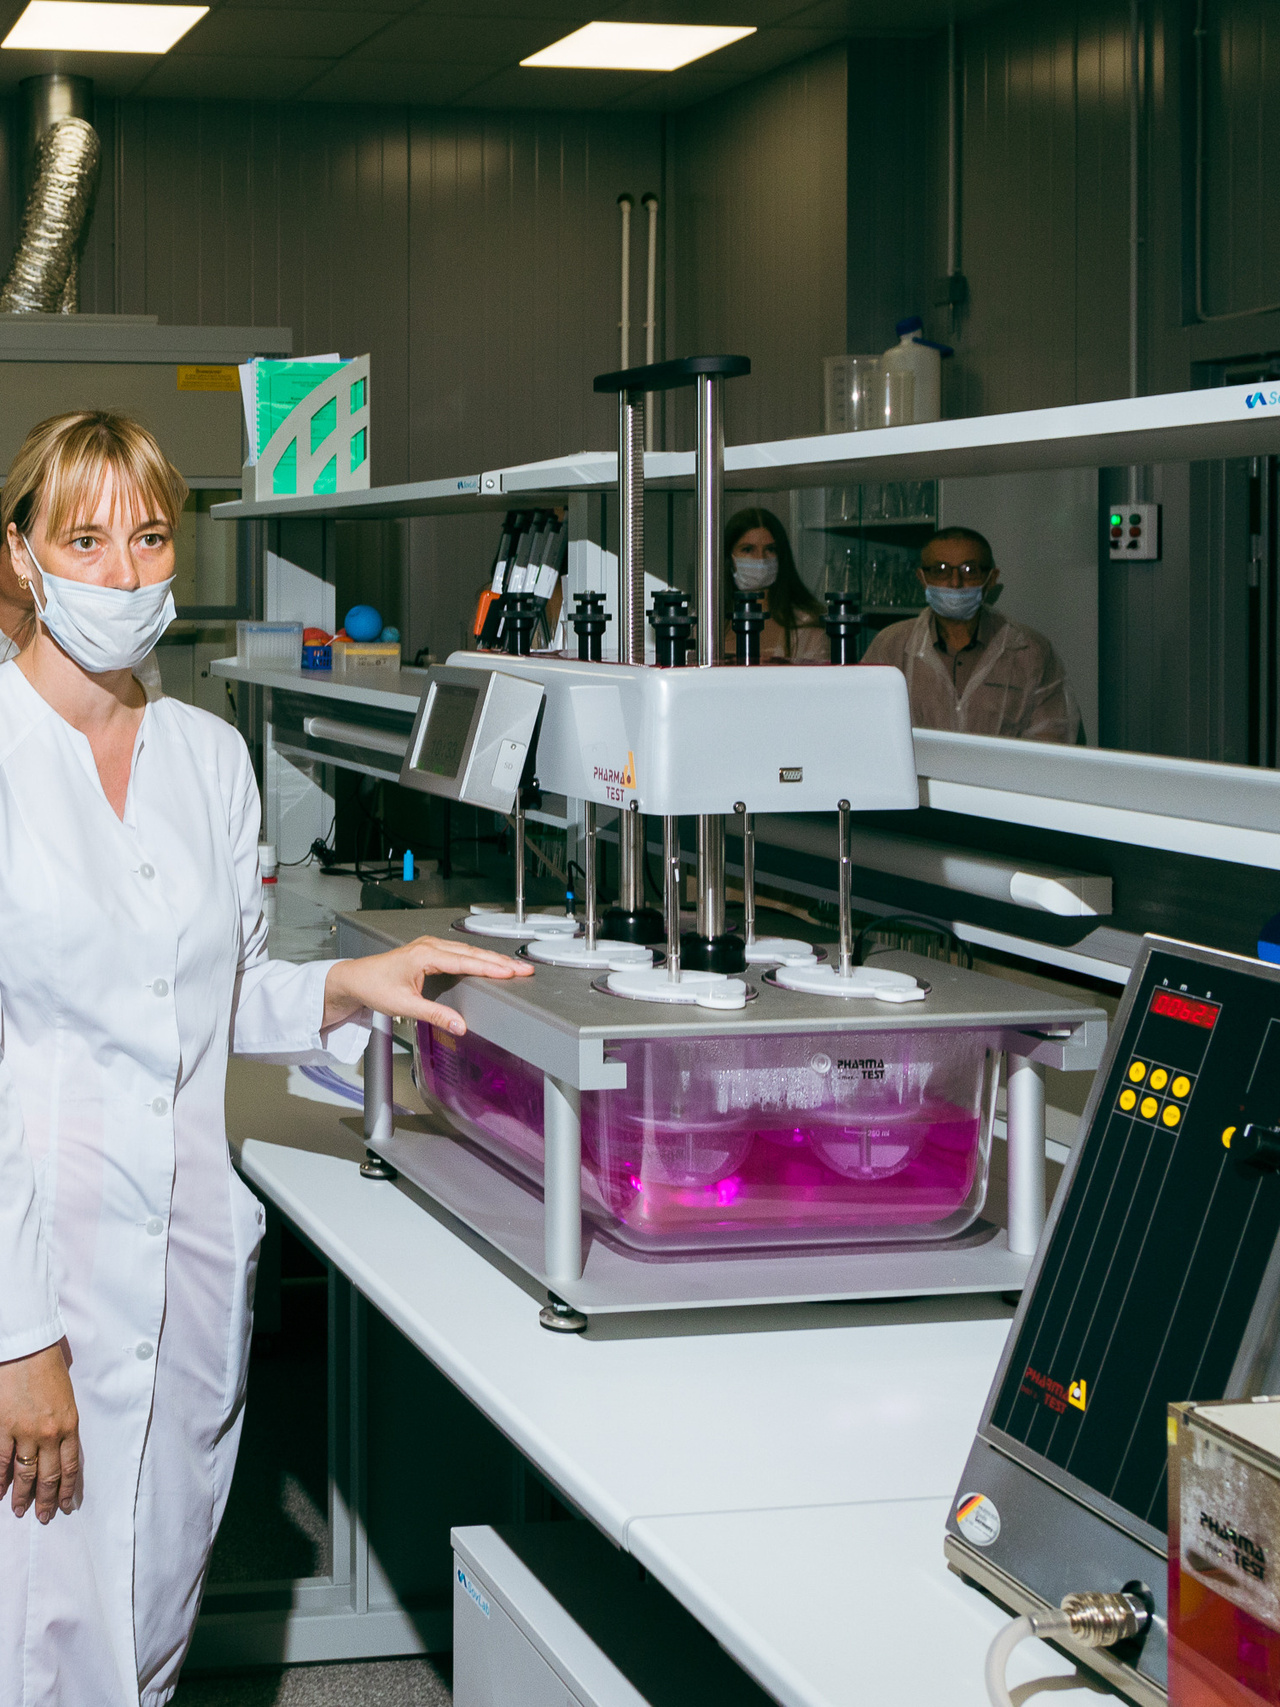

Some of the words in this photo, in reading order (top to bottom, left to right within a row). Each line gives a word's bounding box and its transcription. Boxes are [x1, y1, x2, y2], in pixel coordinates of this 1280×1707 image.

[1269, 391, 1280, 405] S
[593, 766, 625, 785] PHARMA
[606, 786, 624, 802] TEST
[837, 1059, 884, 1069] PHARMA
[862, 1070, 885, 1080] TEST
[1025, 1366, 1069, 1402] PHARMA
[1044, 1393, 1067, 1414] TEST
[1200, 1511, 1265, 1563] PHARMA
[1233, 1549, 1265, 1581] TEST
